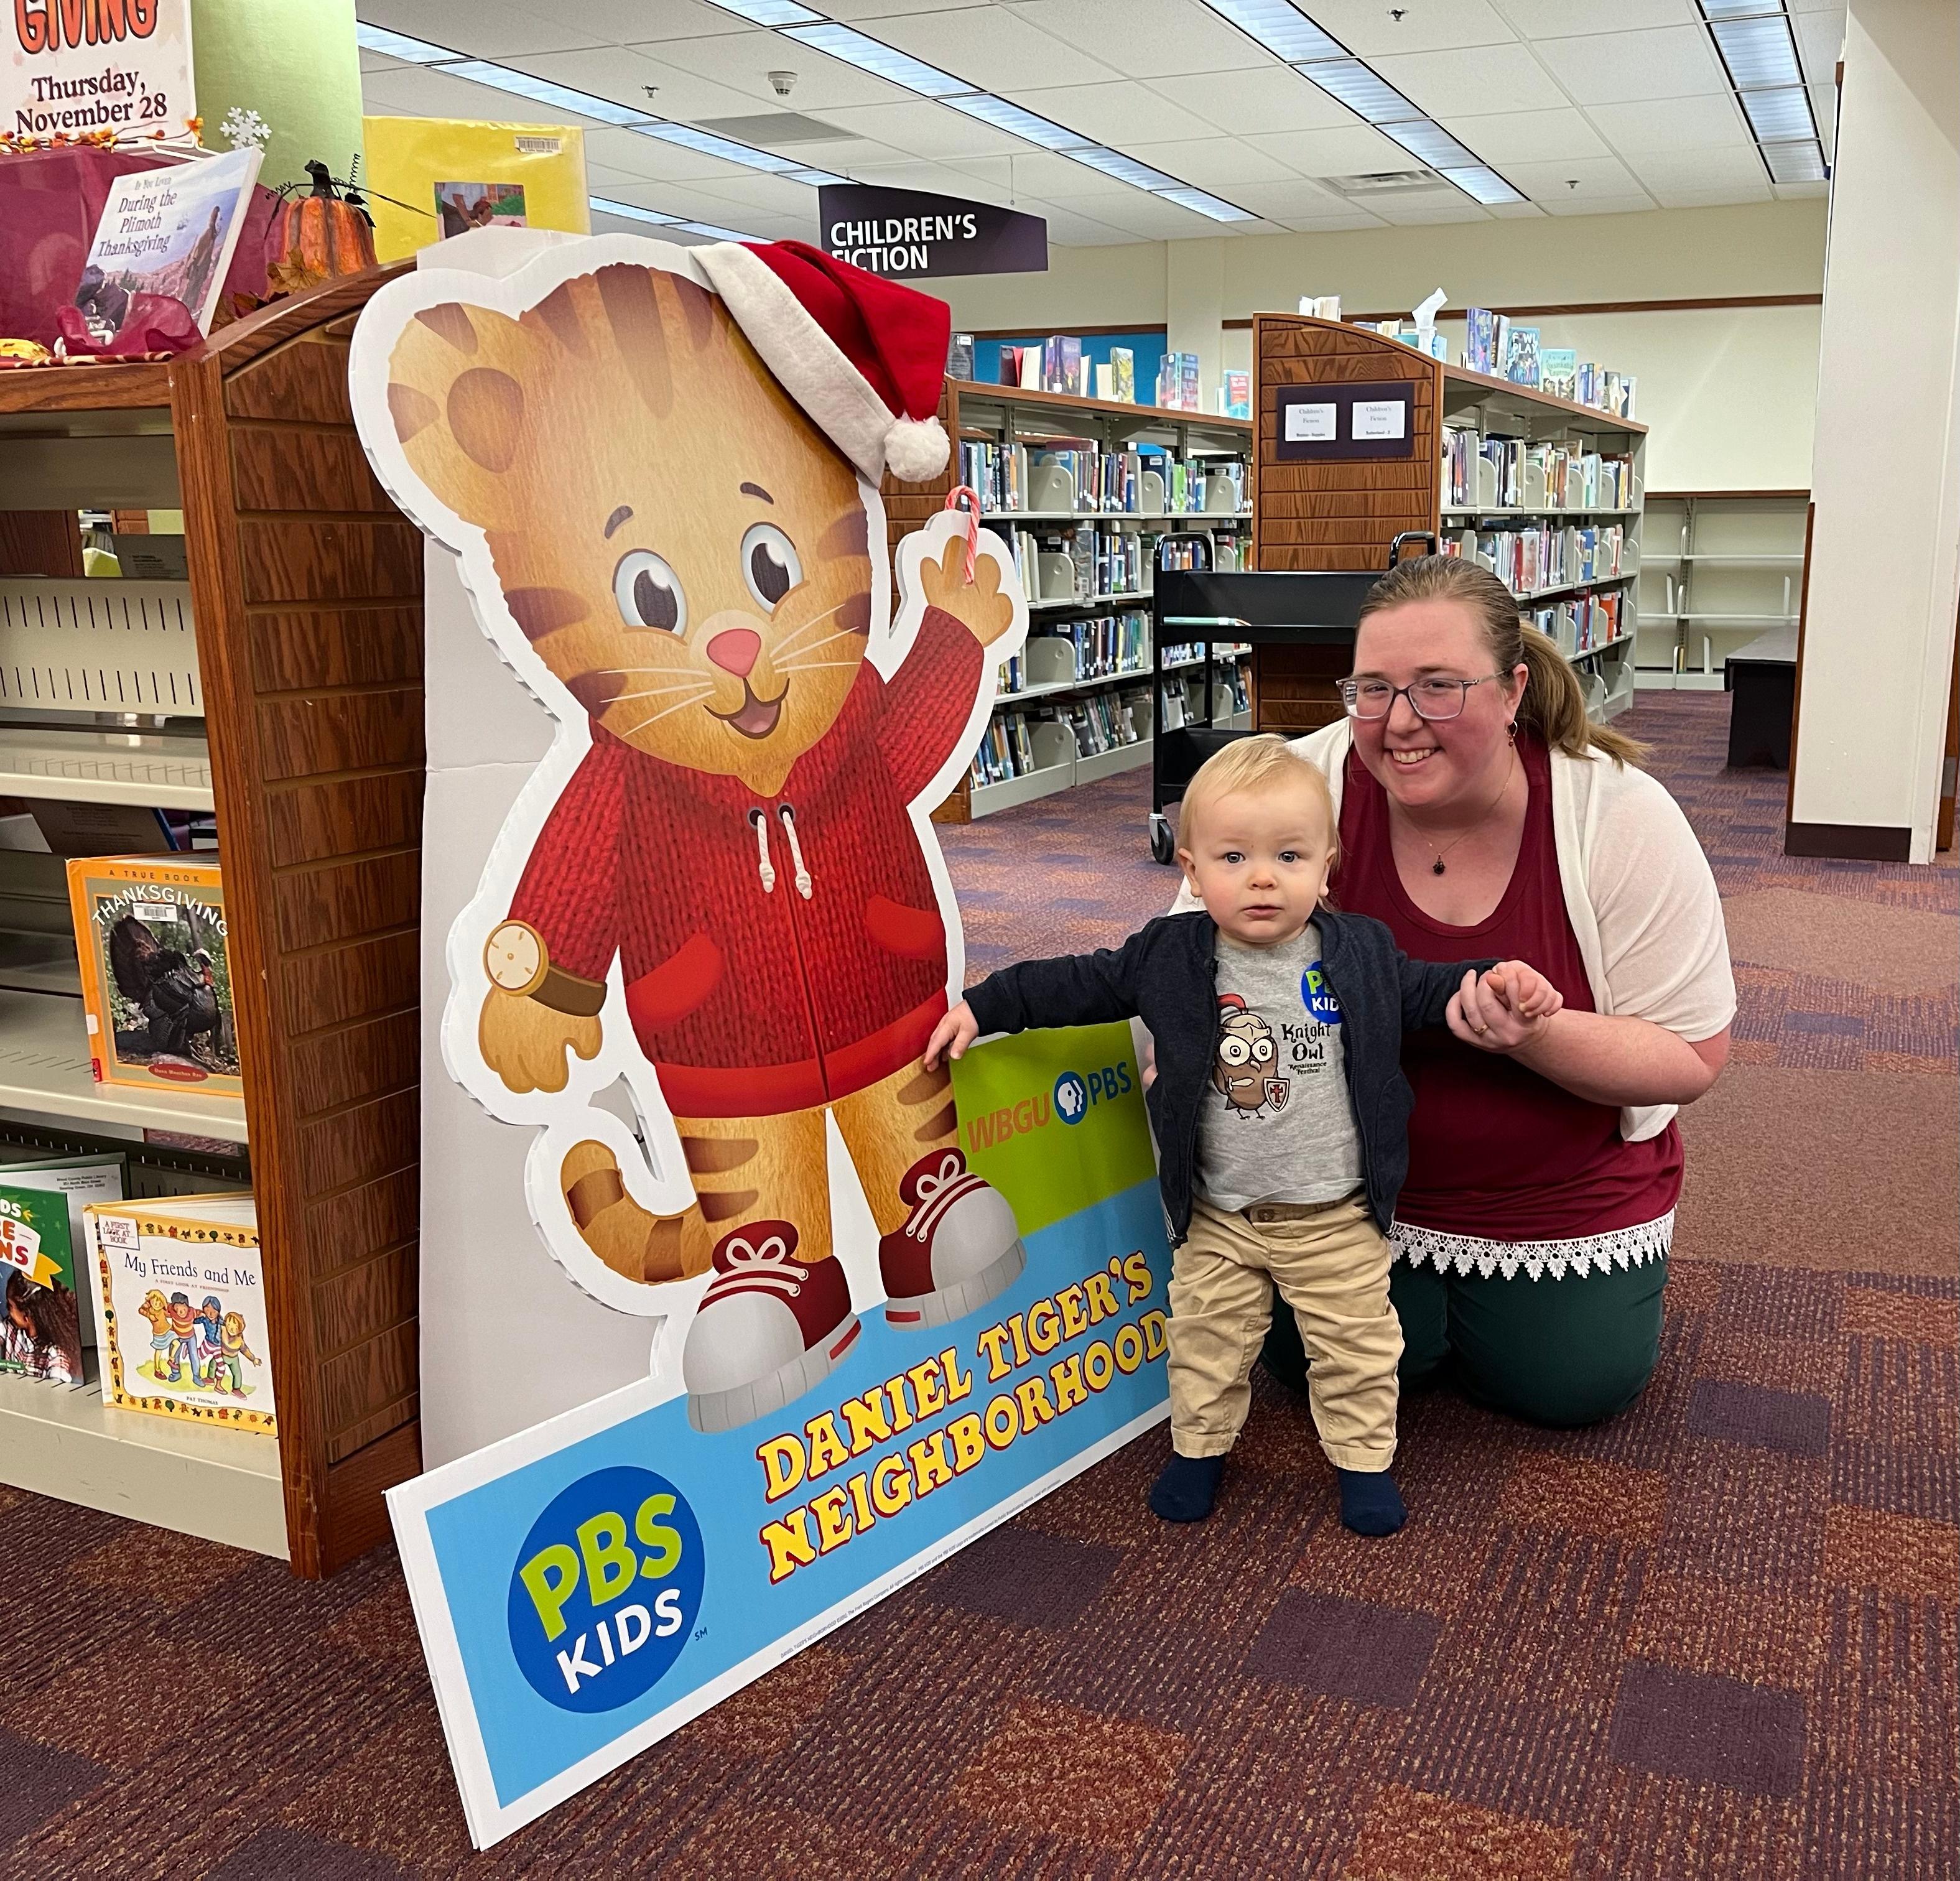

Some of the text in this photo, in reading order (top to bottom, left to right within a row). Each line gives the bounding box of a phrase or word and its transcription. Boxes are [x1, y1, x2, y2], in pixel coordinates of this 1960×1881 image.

[15, 0, 157, 54] GIVING
[32, 68, 146, 101] Thursday,
[16, 93, 167, 134] November 28
[119, 189, 177, 213] During the
[119, 211, 162, 233] Plimoth
[831, 214, 977, 247] CHILDREN'S
[98, 235, 170, 257] Thanksgiving
[832, 245, 928, 272] FICTION
[1513, 342, 1538, 354] PLAY
[124, 870, 155, 879] TRUE
[165, 873, 200, 883] BOOK
[92, 885, 228, 936] THANKSGIVING
[1306, 970, 1334, 994] P
[1281, 1021, 1331, 1044] Knight
[1292, 1043, 1324, 1061] Owl
[967, 1062, 1132, 1154] WBGU PBS
[110, 1221, 130, 1230] FIRST
[110, 1235, 128, 1245] BOOK
[124, 1252, 256, 1286] My Friends and Me
[757, 1250, 1153, 1503] DANIEL TIGER'S
[759, 1309, 1168, 1585] NEIGHBORHOOD
[519, 1493, 683, 1643] PBS
[555, 1589, 684, 1694] KIDS
[695, 1627, 708, 1641] SM
